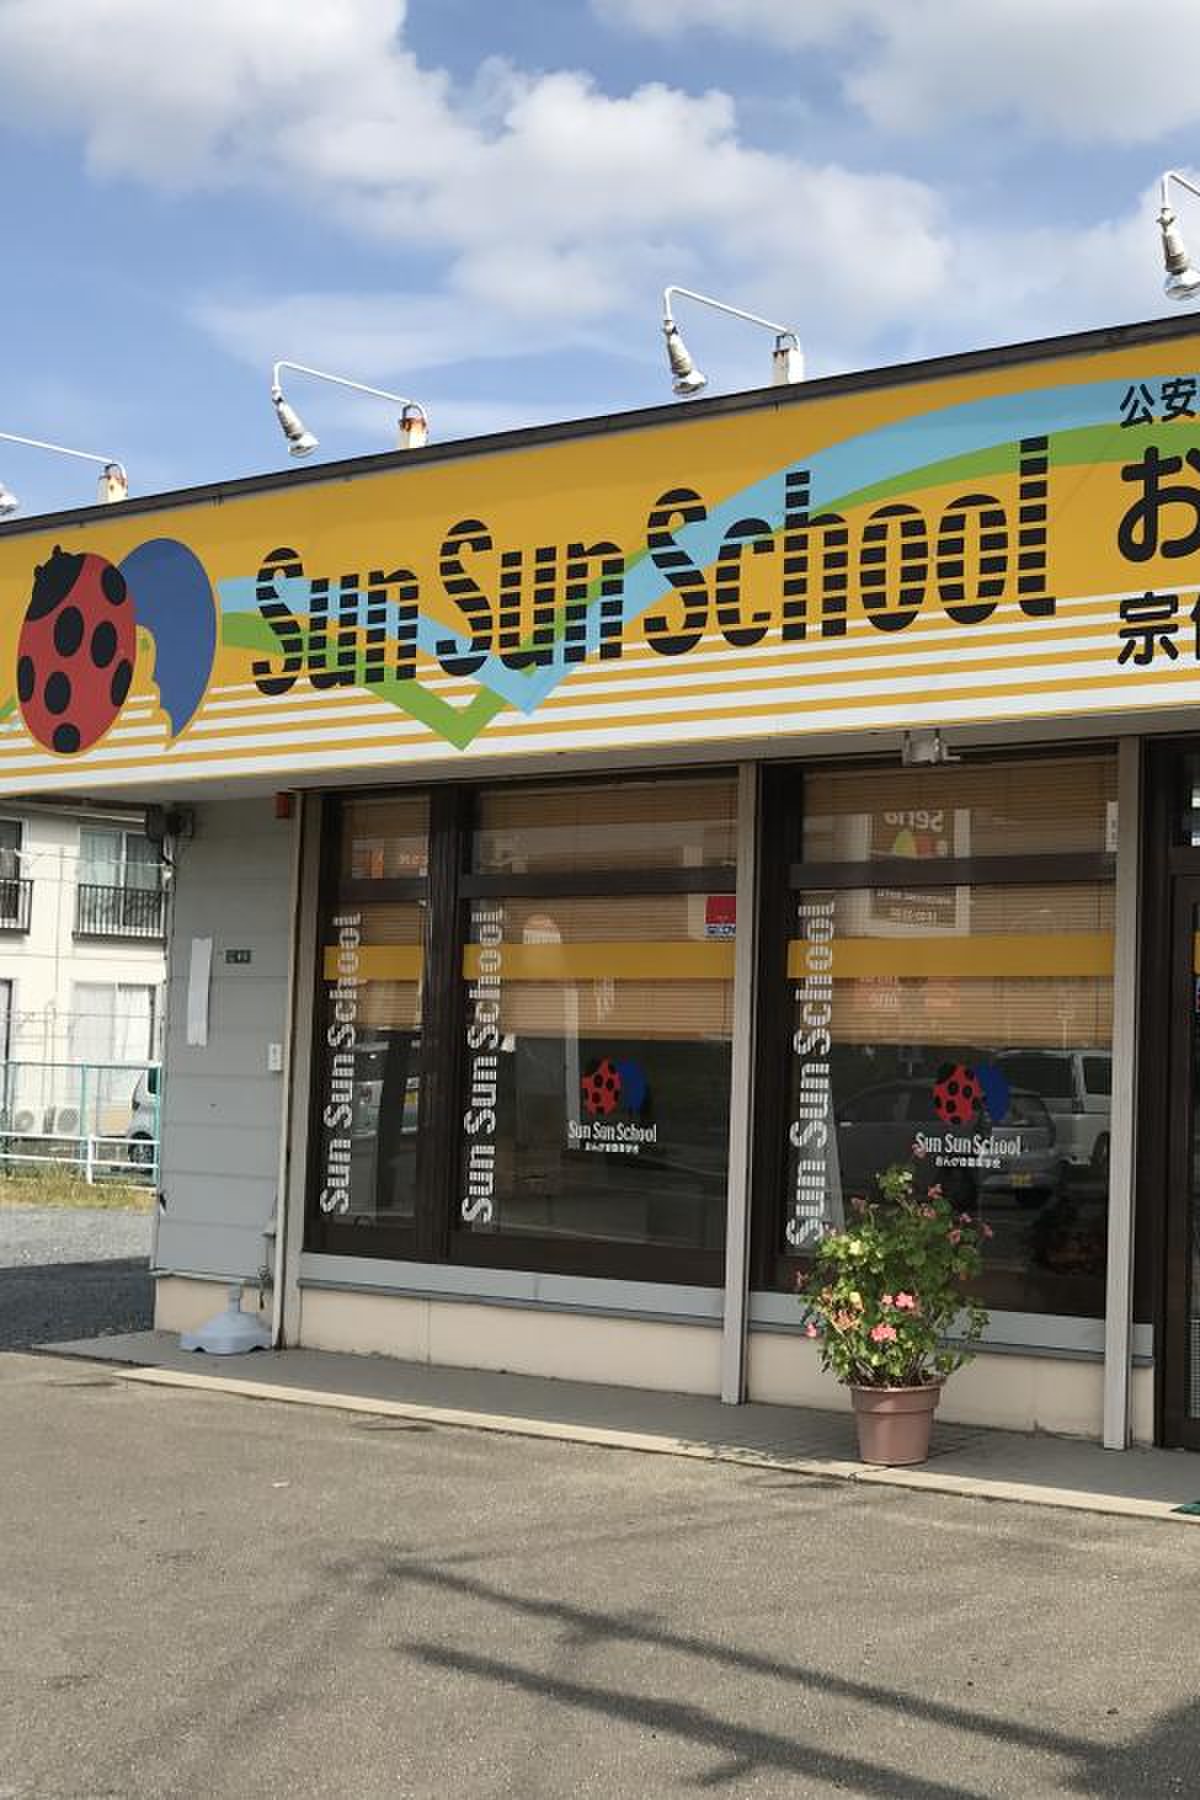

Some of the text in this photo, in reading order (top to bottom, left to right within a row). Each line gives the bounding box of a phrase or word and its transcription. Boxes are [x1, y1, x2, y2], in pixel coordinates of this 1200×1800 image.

[252, 436, 1057, 696] Sun Sun School
[320, 911, 361, 1216] Sun Sun School
[461, 908, 503, 1224] Sun Sun School
[786, 901, 835, 1247] Sun Sun School
[944, 1133, 972, 1153] Sun
[973, 1134, 1021, 1156] School
